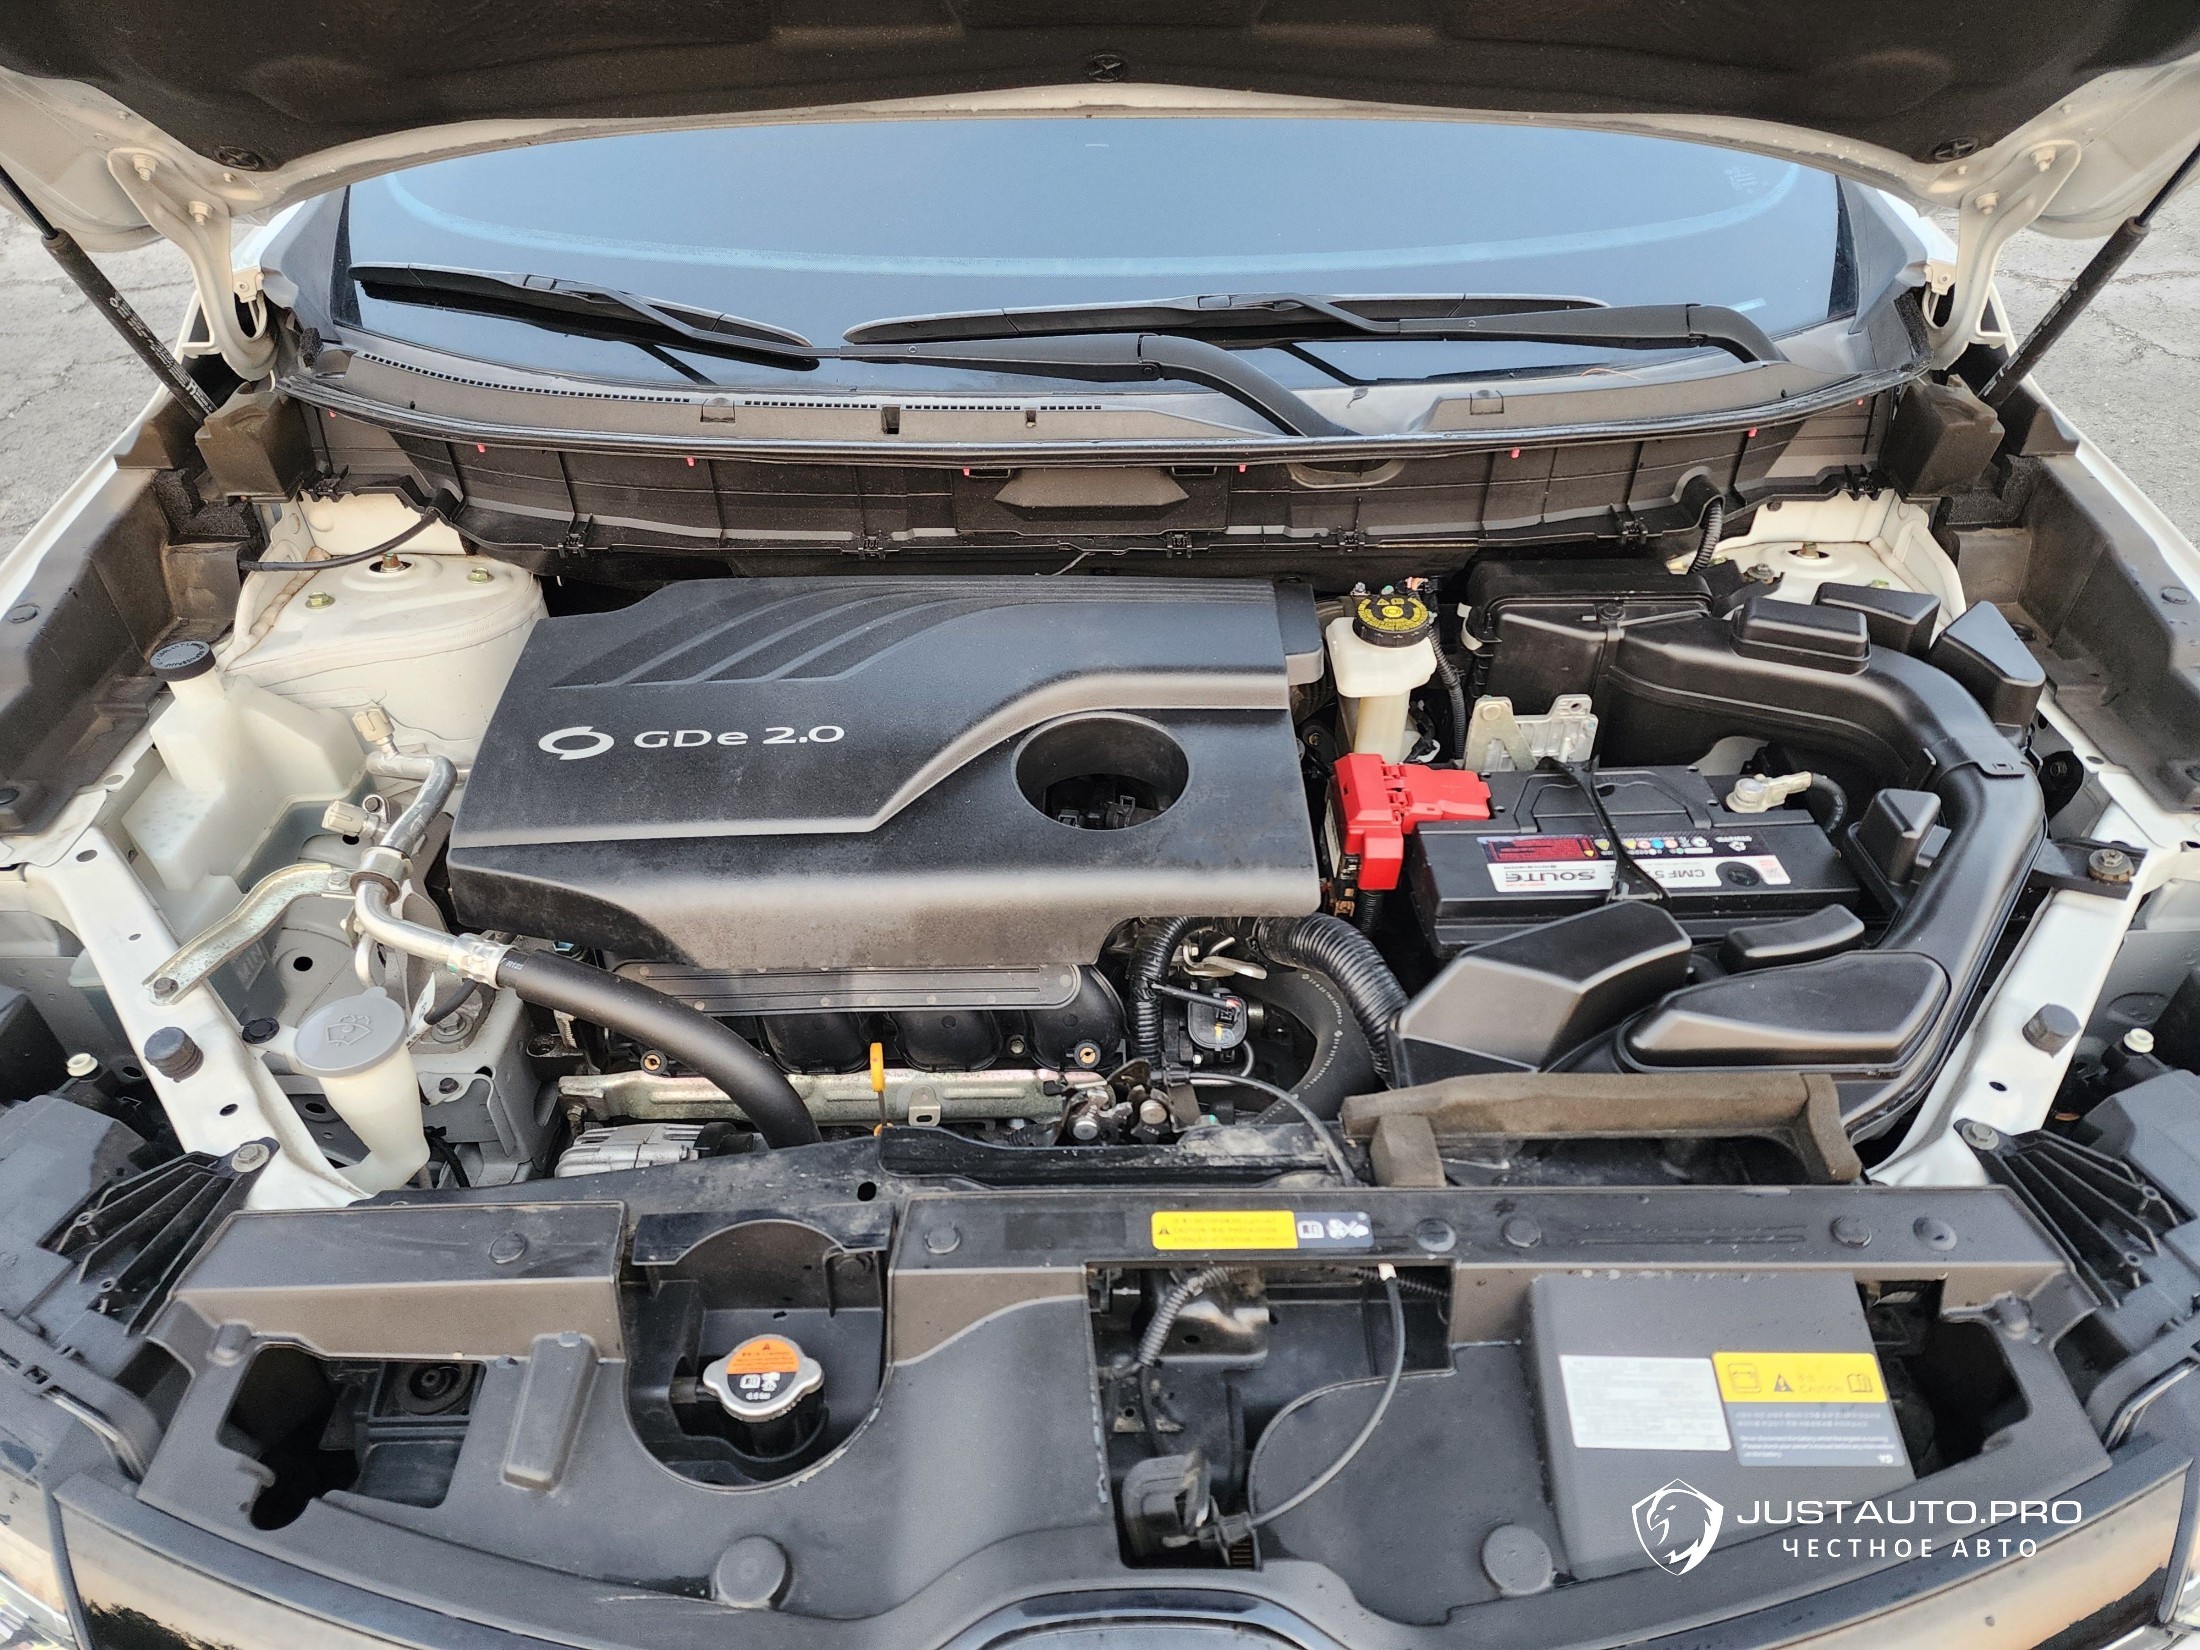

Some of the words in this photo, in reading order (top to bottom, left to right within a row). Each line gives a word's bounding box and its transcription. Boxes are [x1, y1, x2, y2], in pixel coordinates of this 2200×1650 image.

[633, 729, 749, 748] GDe
[762, 725, 846, 745] 2.0
[1505, 871, 1595, 883] SOLITE
[1668, 869, 1705, 879] CMF
